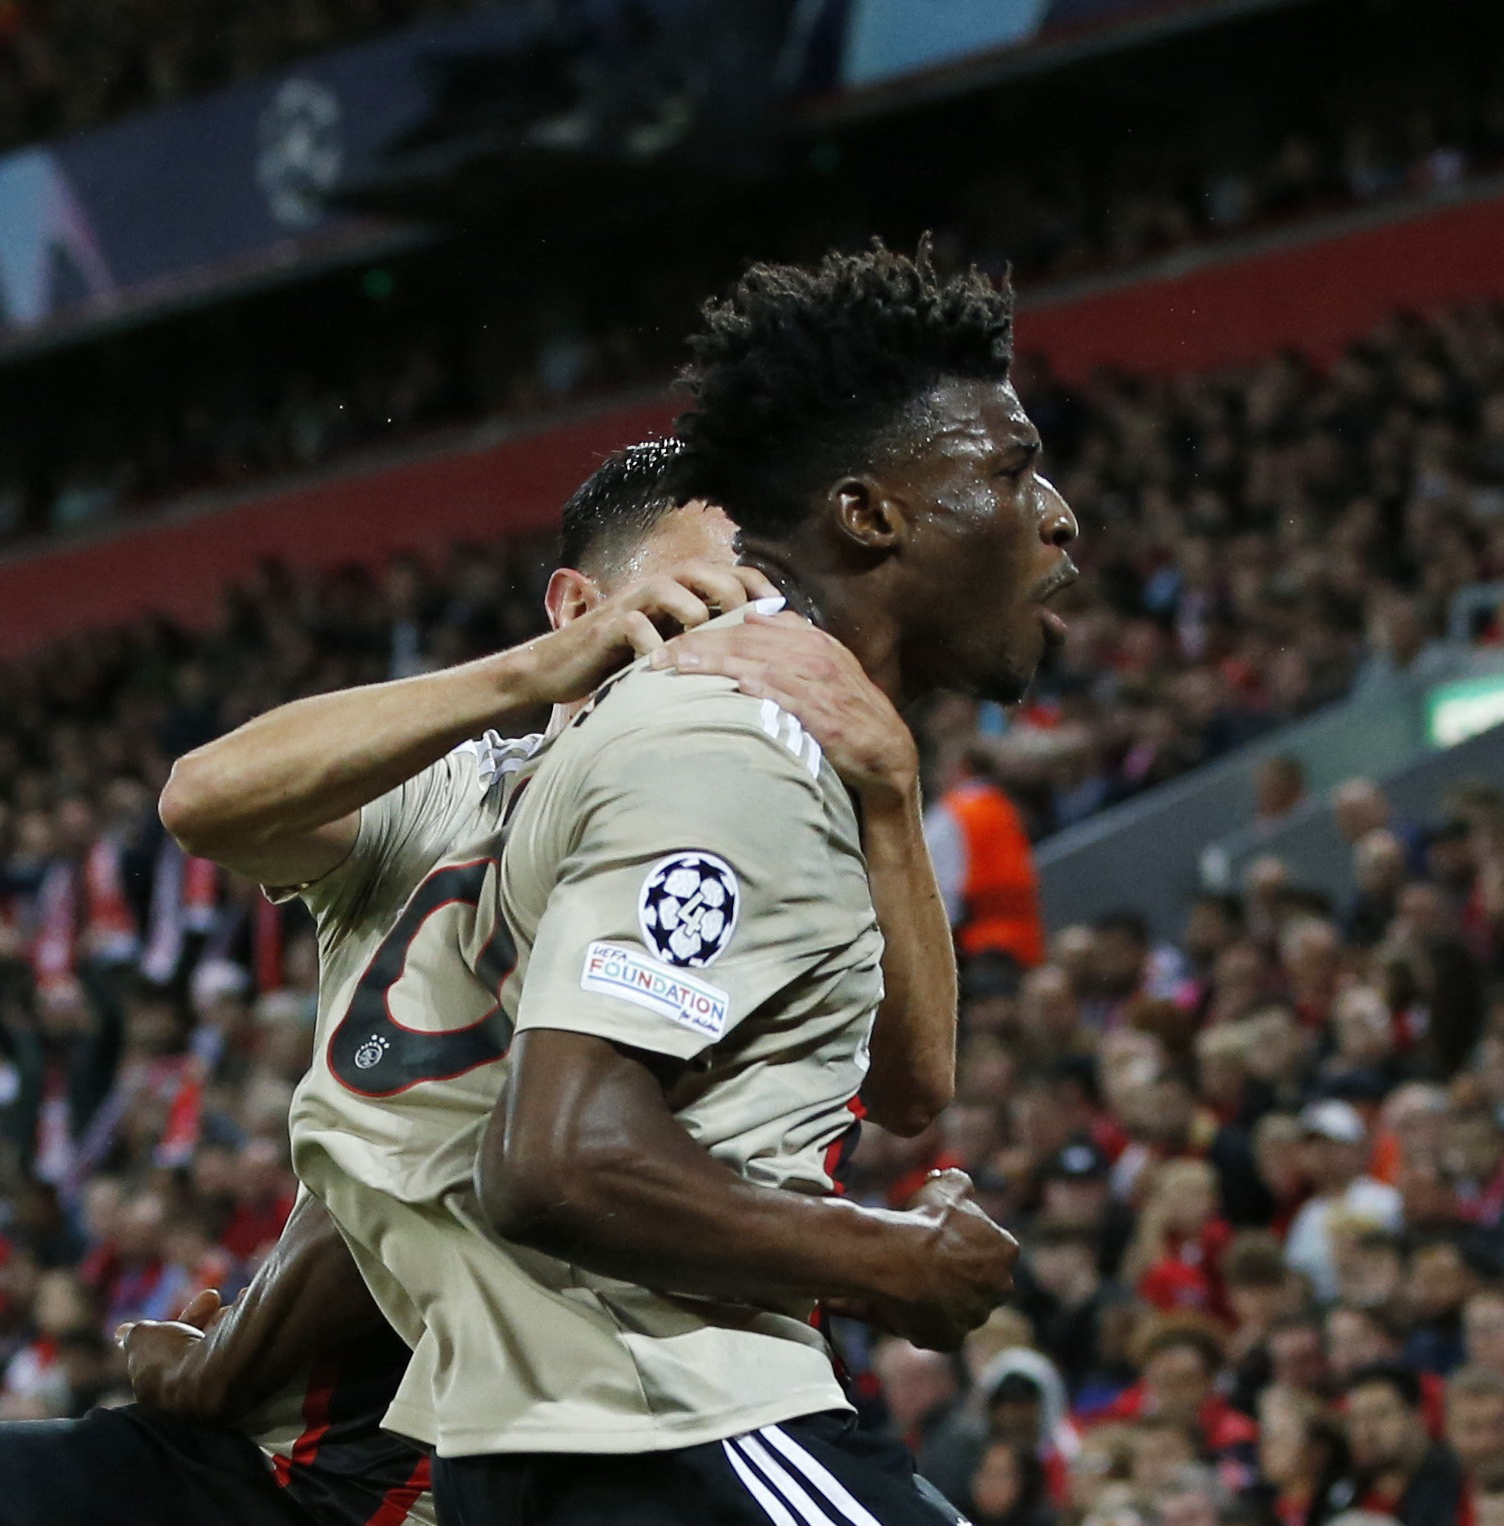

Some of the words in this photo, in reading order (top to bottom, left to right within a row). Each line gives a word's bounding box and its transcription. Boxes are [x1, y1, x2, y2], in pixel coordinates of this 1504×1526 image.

[676, 892, 704, 938] 4
[593, 945, 628, 962] UEFA
[589, 958, 724, 1021] FOUNDATION
